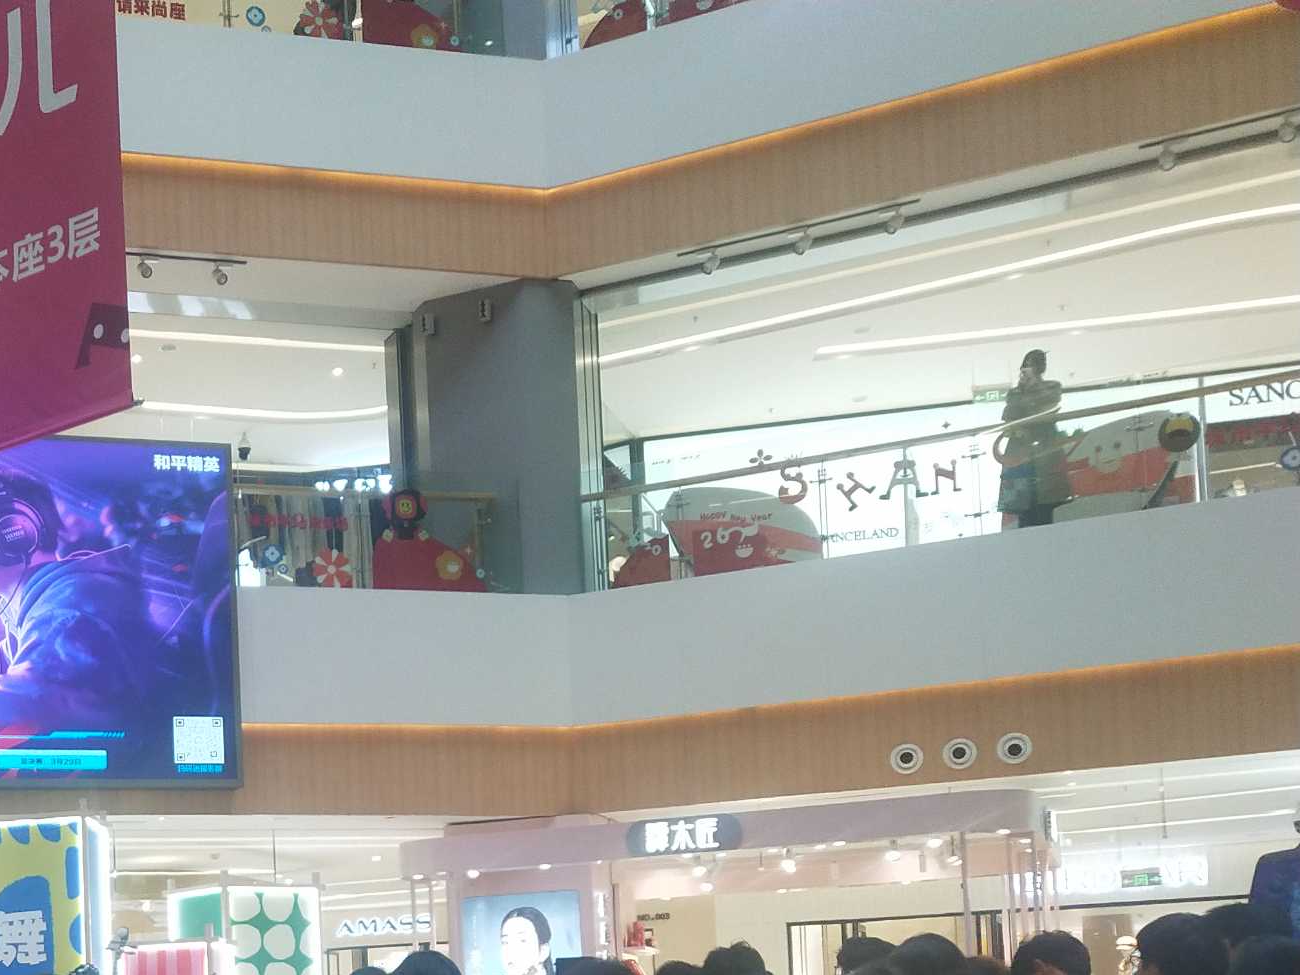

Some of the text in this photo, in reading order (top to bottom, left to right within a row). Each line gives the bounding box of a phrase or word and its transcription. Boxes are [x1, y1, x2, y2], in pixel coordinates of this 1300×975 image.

[154, 454, 220, 472] 和平精英
[336, 912, 432, 937] AMASS
